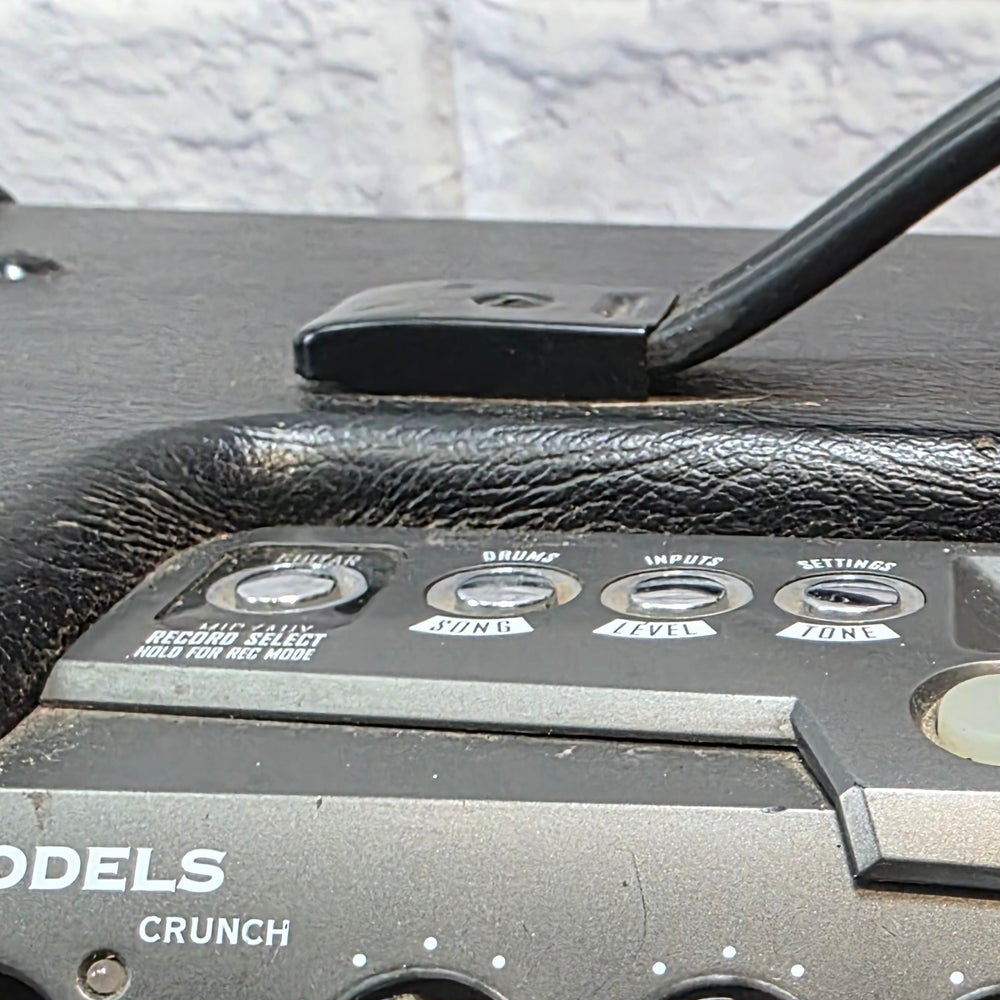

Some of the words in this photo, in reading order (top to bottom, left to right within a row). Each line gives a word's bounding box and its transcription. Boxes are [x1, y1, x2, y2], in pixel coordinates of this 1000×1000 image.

[482, 550, 561, 563] DRUMS
[644, 554, 724, 567] INPUTS
[797, 558, 898, 572] SETTINGS
[430, 617, 512, 635] SONG
[612, 620, 697, 637] LEVEL
[802, 624, 878, 639] TONE
[146, 631, 239, 645] RECORD
[244, 633, 327, 647] SELECT
[134, 646, 184, 658] HOLD
[185, 646, 223, 659] FOR
[225, 648, 263, 660] REC
[264, 648, 316, 661] MODE
[138, 915, 291, 947] CRUNCH
